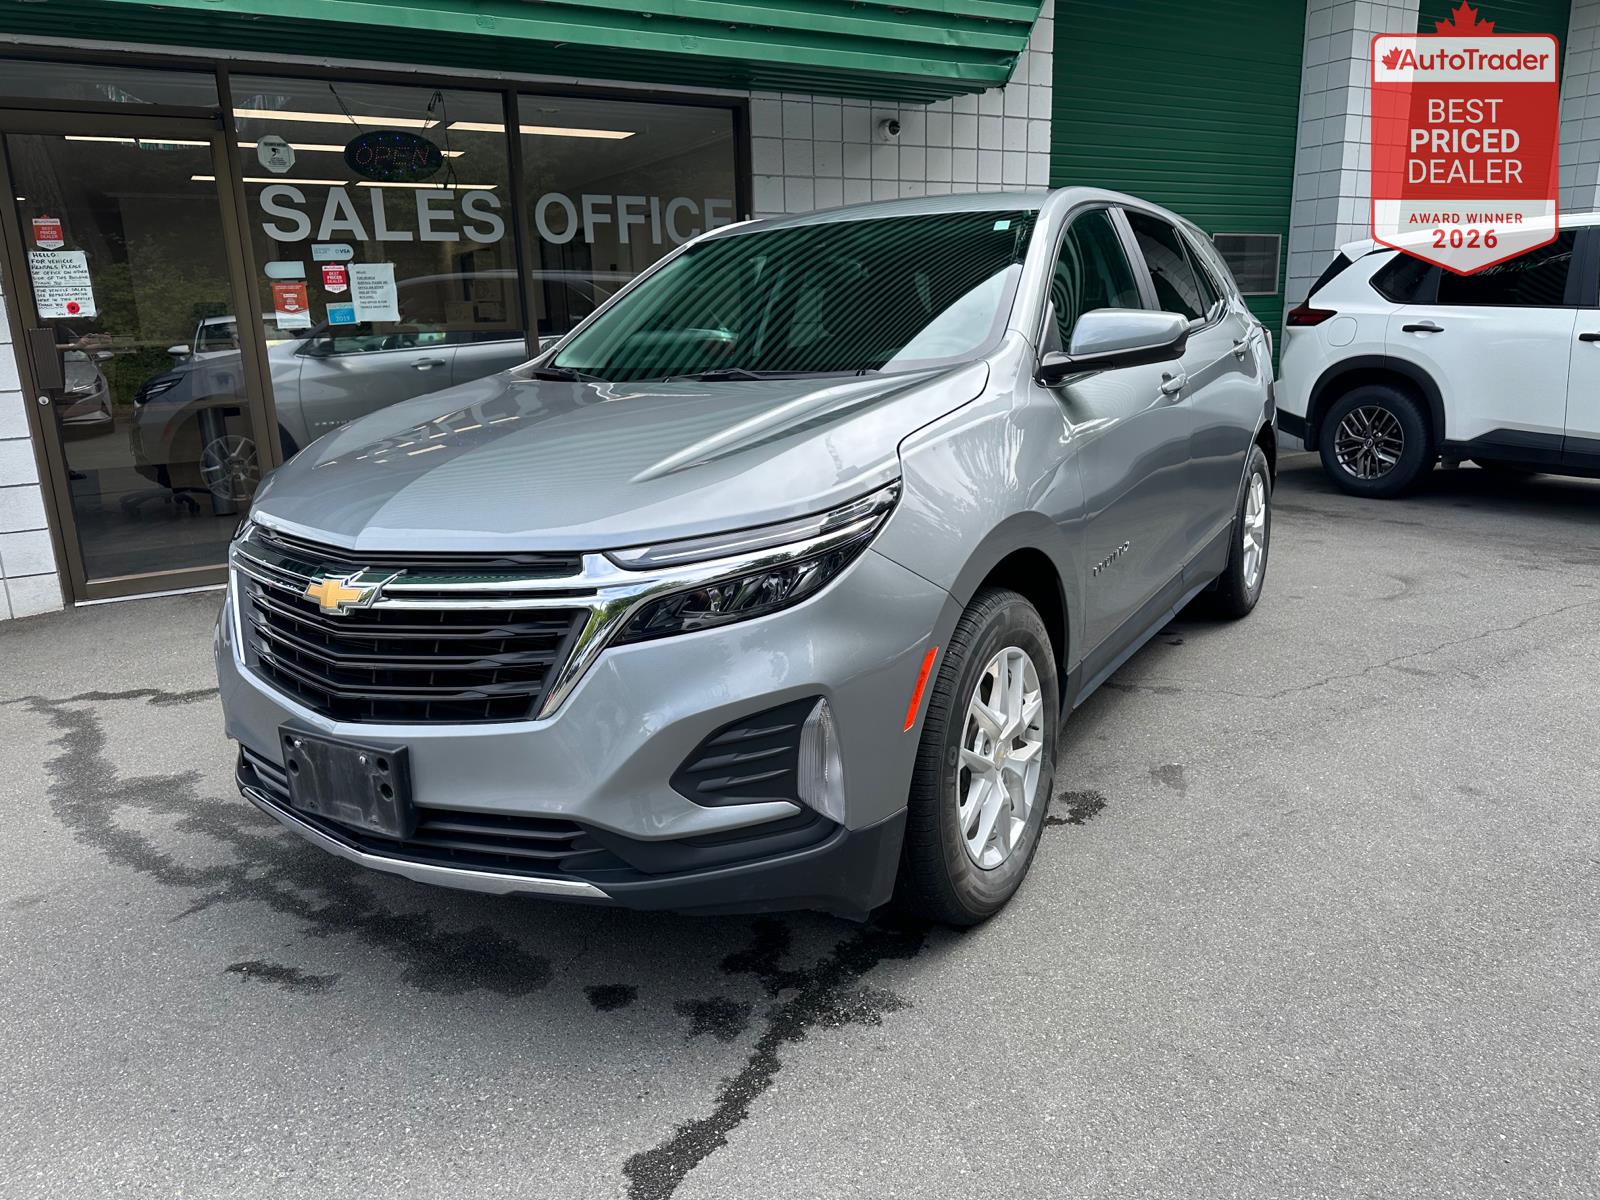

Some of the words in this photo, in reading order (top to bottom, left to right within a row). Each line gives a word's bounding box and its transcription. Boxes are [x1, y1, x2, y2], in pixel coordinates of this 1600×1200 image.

[356, 145, 430, 166] OPEN
[259, 185, 504, 243] SALES
[534, 193, 732, 244] OFFICE
